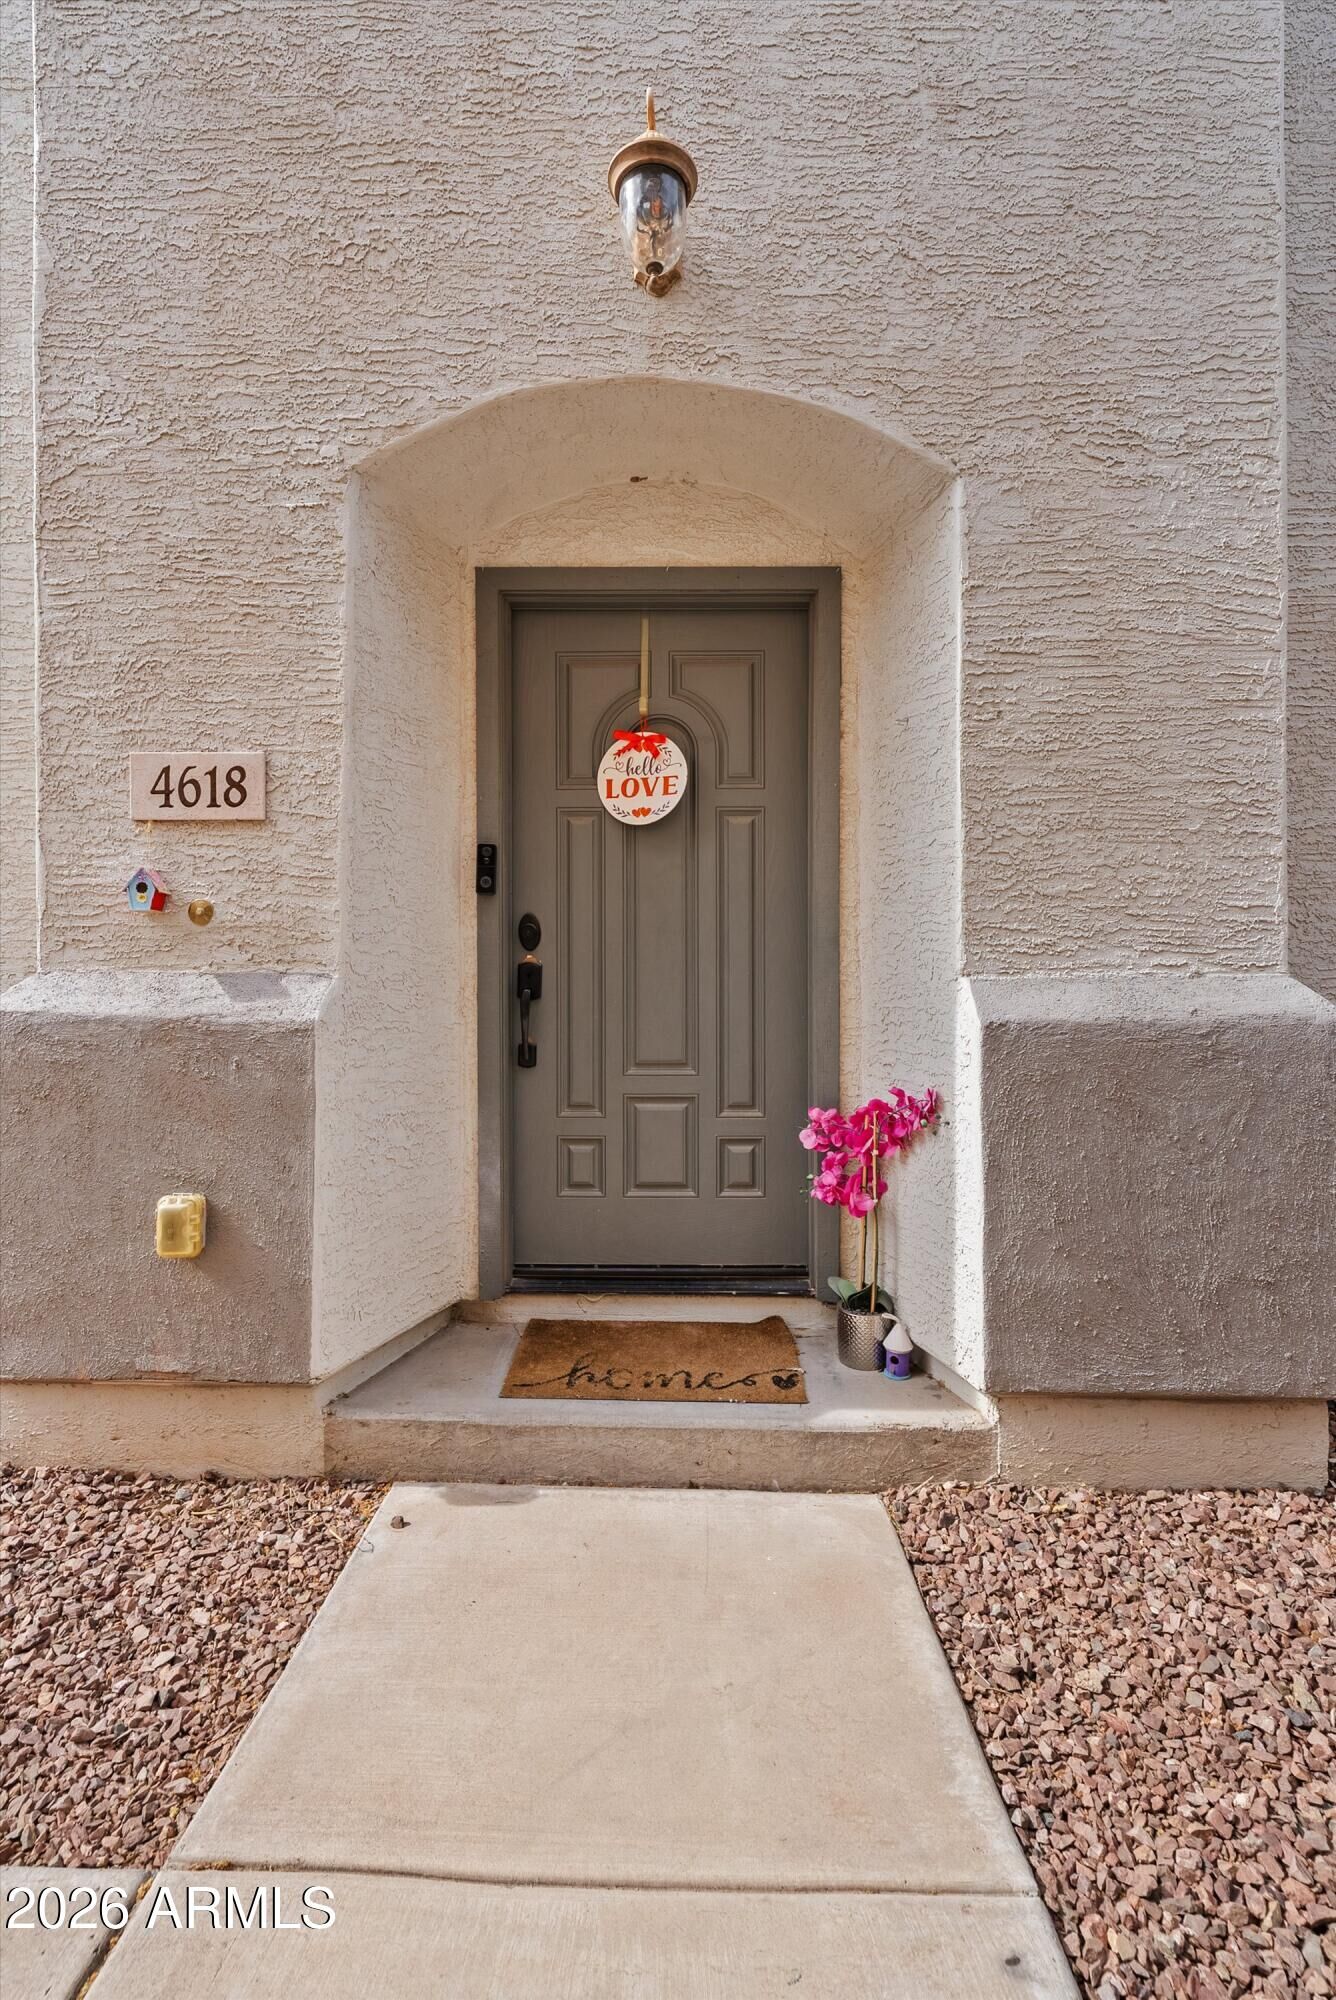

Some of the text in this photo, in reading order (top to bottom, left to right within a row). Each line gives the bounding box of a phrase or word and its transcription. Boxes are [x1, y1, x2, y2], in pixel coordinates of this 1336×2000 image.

[625, 756, 662, 777] hello
[150, 764, 248, 808] 4618
[605, 775, 679, 800] LOVE
[556, 1352, 757, 1391] home
